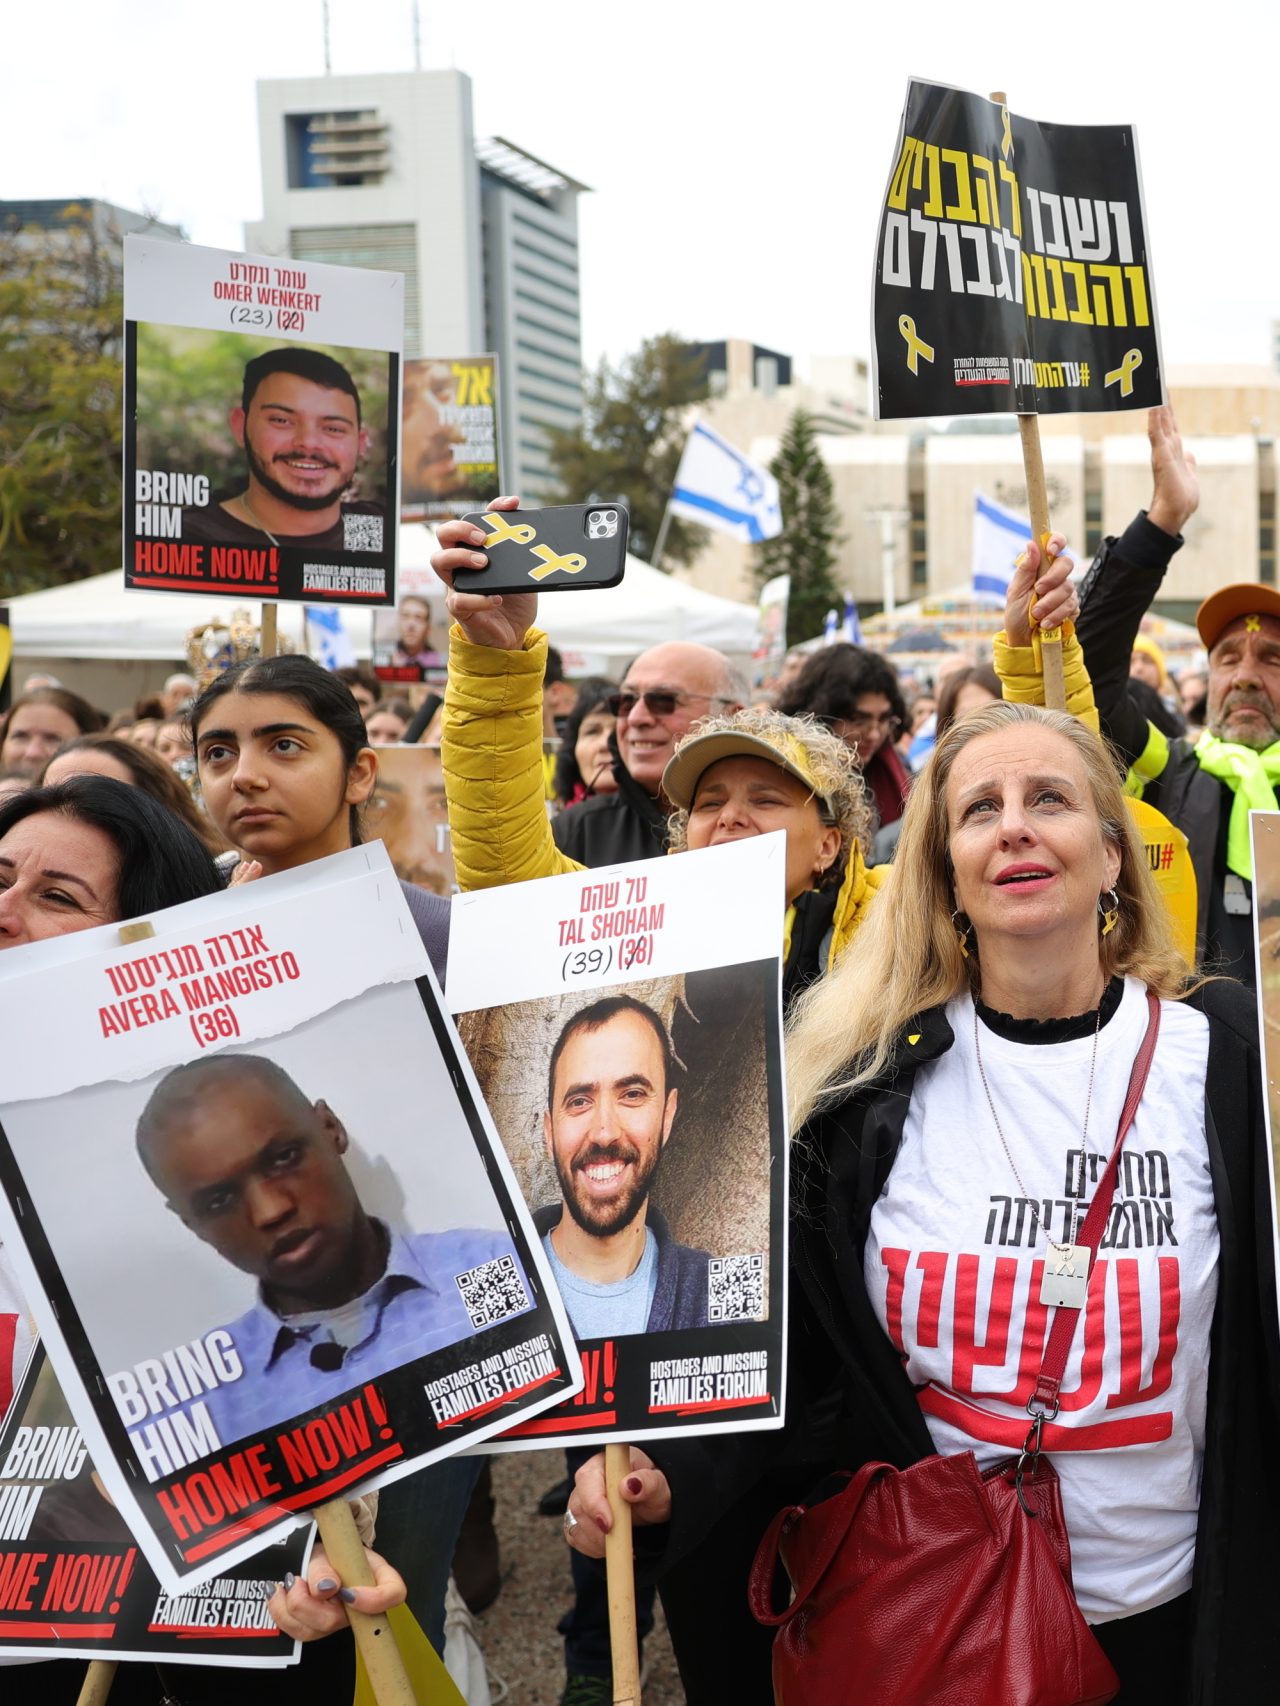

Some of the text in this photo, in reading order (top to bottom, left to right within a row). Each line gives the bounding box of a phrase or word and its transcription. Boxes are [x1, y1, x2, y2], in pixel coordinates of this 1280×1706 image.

[887, 136, 1001, 229] הבנים
[1026, 187, 1134, 263] ושבו
[229, 262, 306, 290] עומר ונקרט
[882, 208, 1023, 304] לגבולם
[213, 281, 322, 312] OMER WENKERT
[230, 305, 273, 329] (23)
[135, 470, 210, 507] BRING
[135, 504, 182, 539] HIM
[134, 541, 280, 583] HOME NOW!
[303, 563, 386, 579] HOSTAGES AND MISSING
[303, 575, 348, 592] FAMILIES
[350, 577, 386, 594] FORUM
[580, 876, 649, 913] טל שהם
[558, 903, 666, 947] TAL SHOHAM
[104, 924, 270, 996] אברה מנגיסטו
[561, 945, 613, 982] (39)
[99, 950, 300, 1038] AVERA MANGISTO
[189, 1010, 240, 1048] (36)
[107, 1330, 244, 1426] BRING
[424, 1334, 549, 1400] HOSTAGES AND MISSING
[431, 1349, 556, 1423] FAMILIES FORUM
[564, 1341, 617, 1407] W!
[650, 1350, 767, 1380] HOSTAGES AND MISSING
[650, 1370, 767, 1407] FAMILIES FORUM
[1, 1427, 88, 1480] BRING
[129, 1400, 223, 1483] HIM
[156, 1384, 394, 1541] HOME NOW!
[0, 1486, 44, 1540] IM
[0, 1547, 138, 1615] ME NOW!
[211, 1579, 236, 1598] AND
[235, 1580, 285, 1599] MISS
[152, 1596, 222, 1628] FAMILIES
